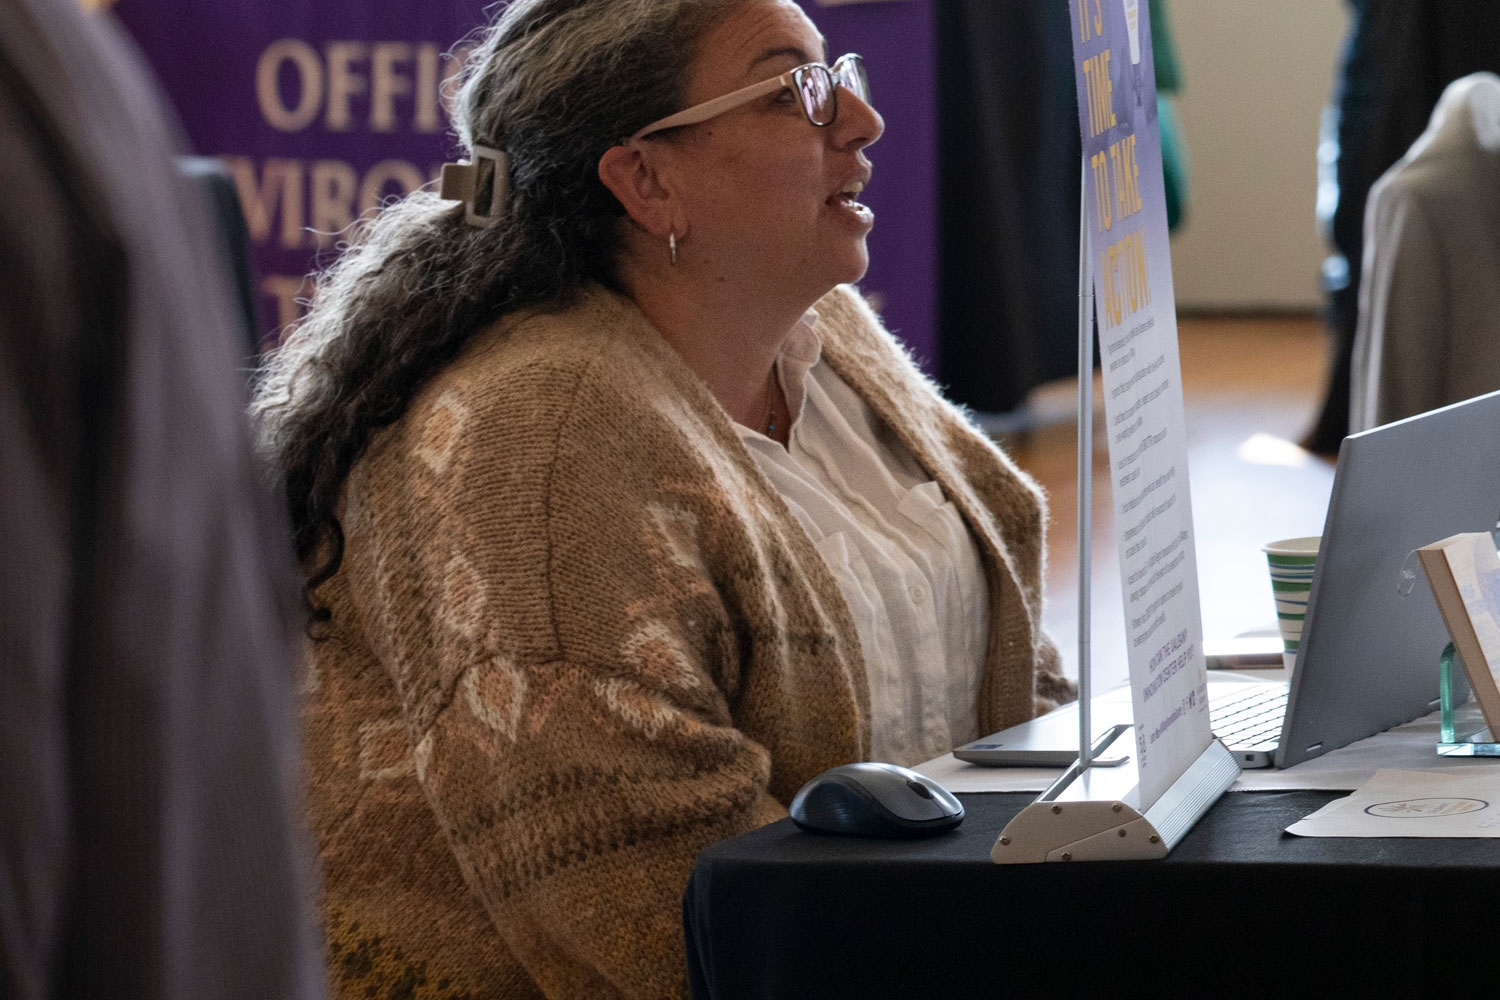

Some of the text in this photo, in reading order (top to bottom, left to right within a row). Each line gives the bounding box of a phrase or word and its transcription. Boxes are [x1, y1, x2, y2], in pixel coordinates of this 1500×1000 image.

[1083, 49, 1116, 138] TIME
[1091, 134, 1142, 234] TO TAKE
